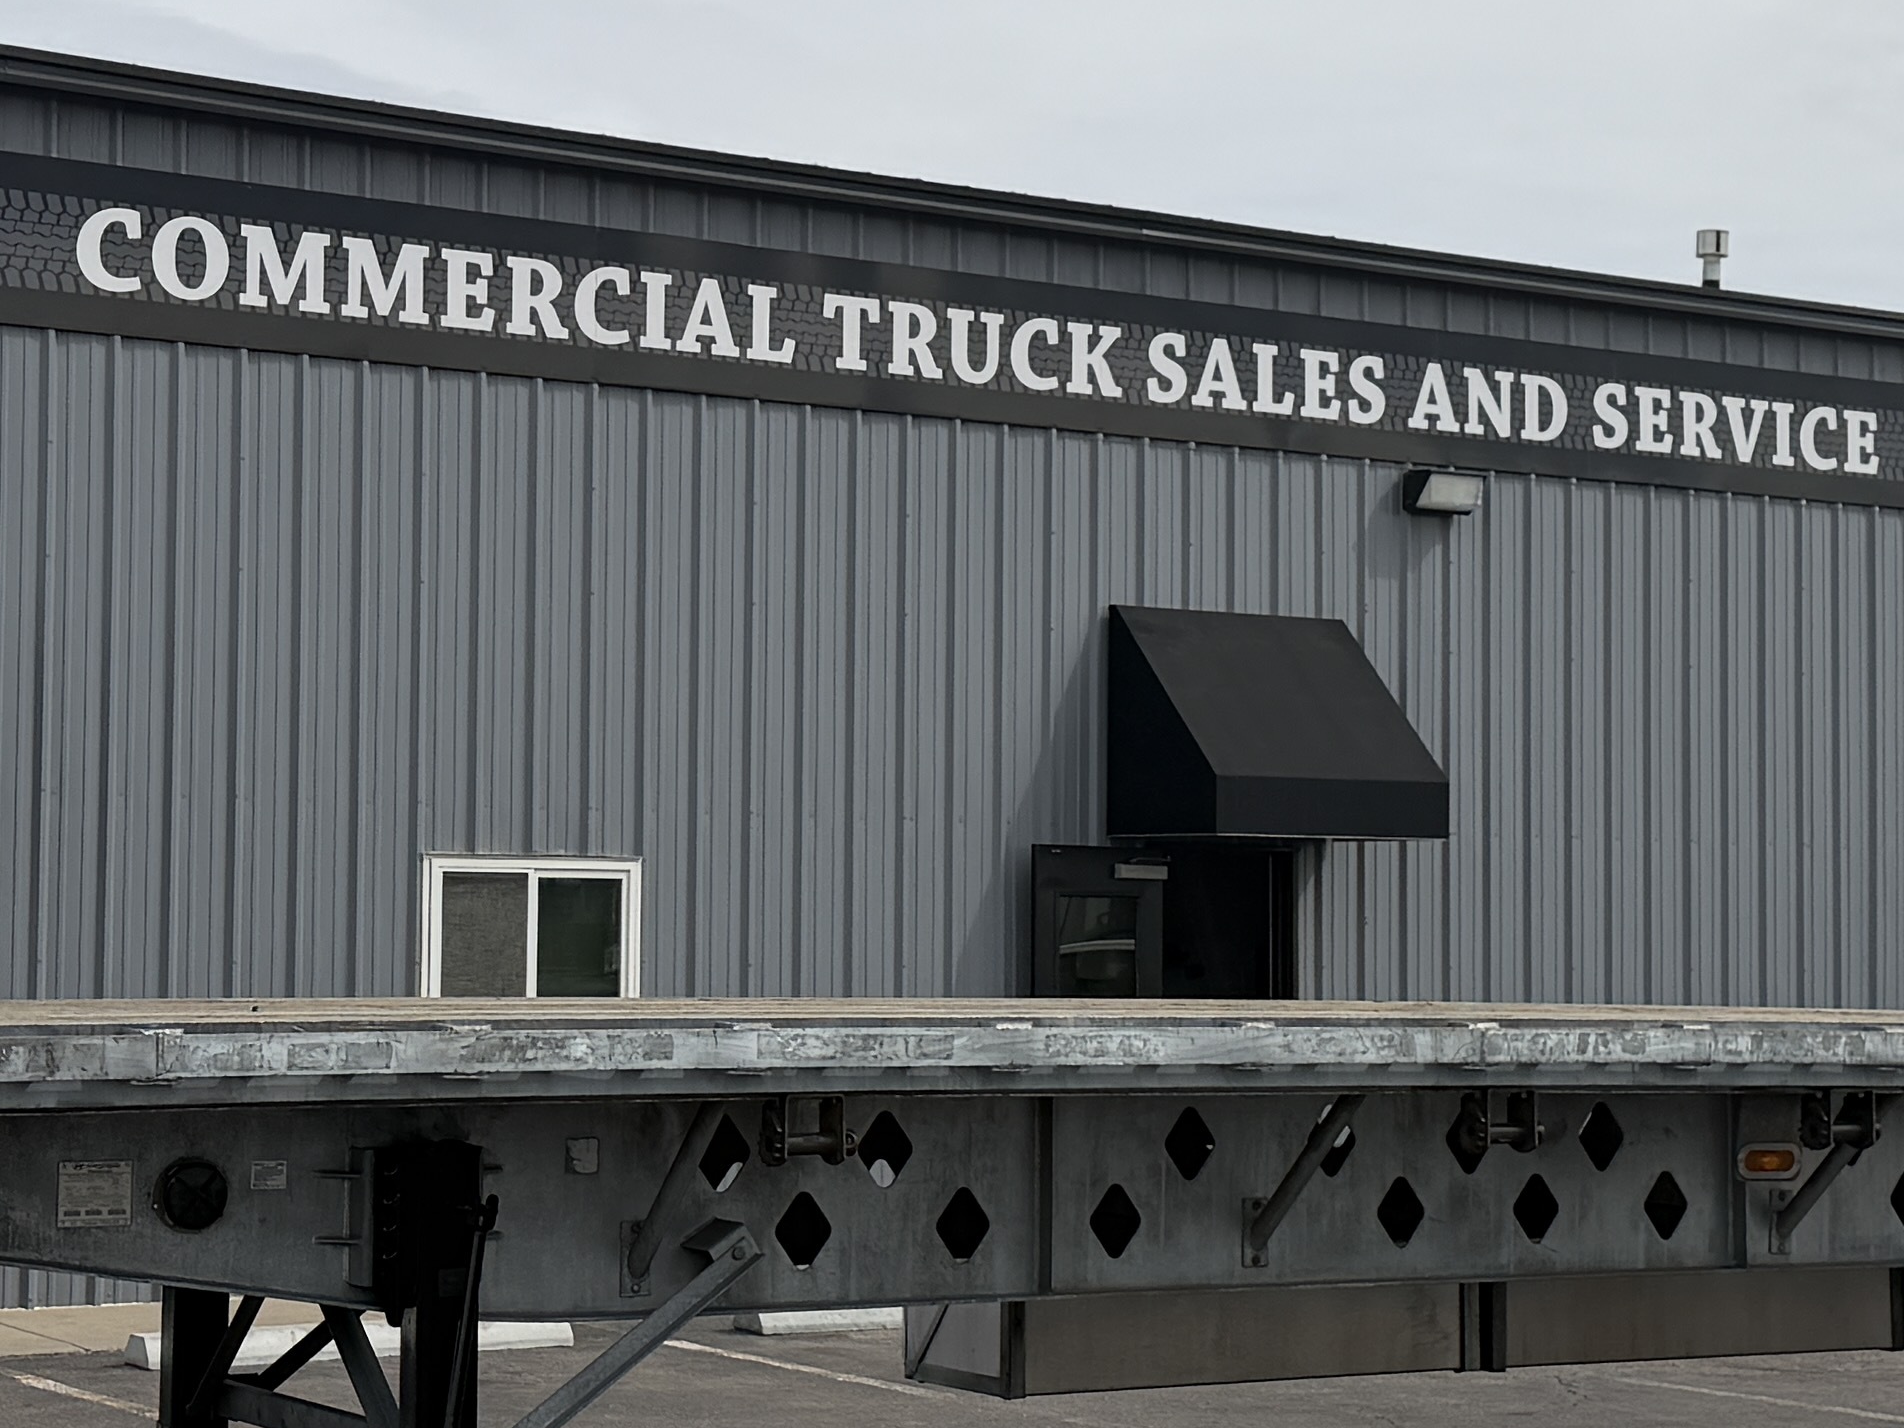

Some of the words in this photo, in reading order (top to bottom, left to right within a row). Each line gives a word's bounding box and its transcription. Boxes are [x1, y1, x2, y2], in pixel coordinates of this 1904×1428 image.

[76, 207, 796, 364] COMMERCIAL
[823, 293, 1123, 398] TRUCK
[1146, 332, 1386, 424] SALES
[1408, 362, 1568, 442] AND
[1592, 382, 1880, 475] SERVICE
